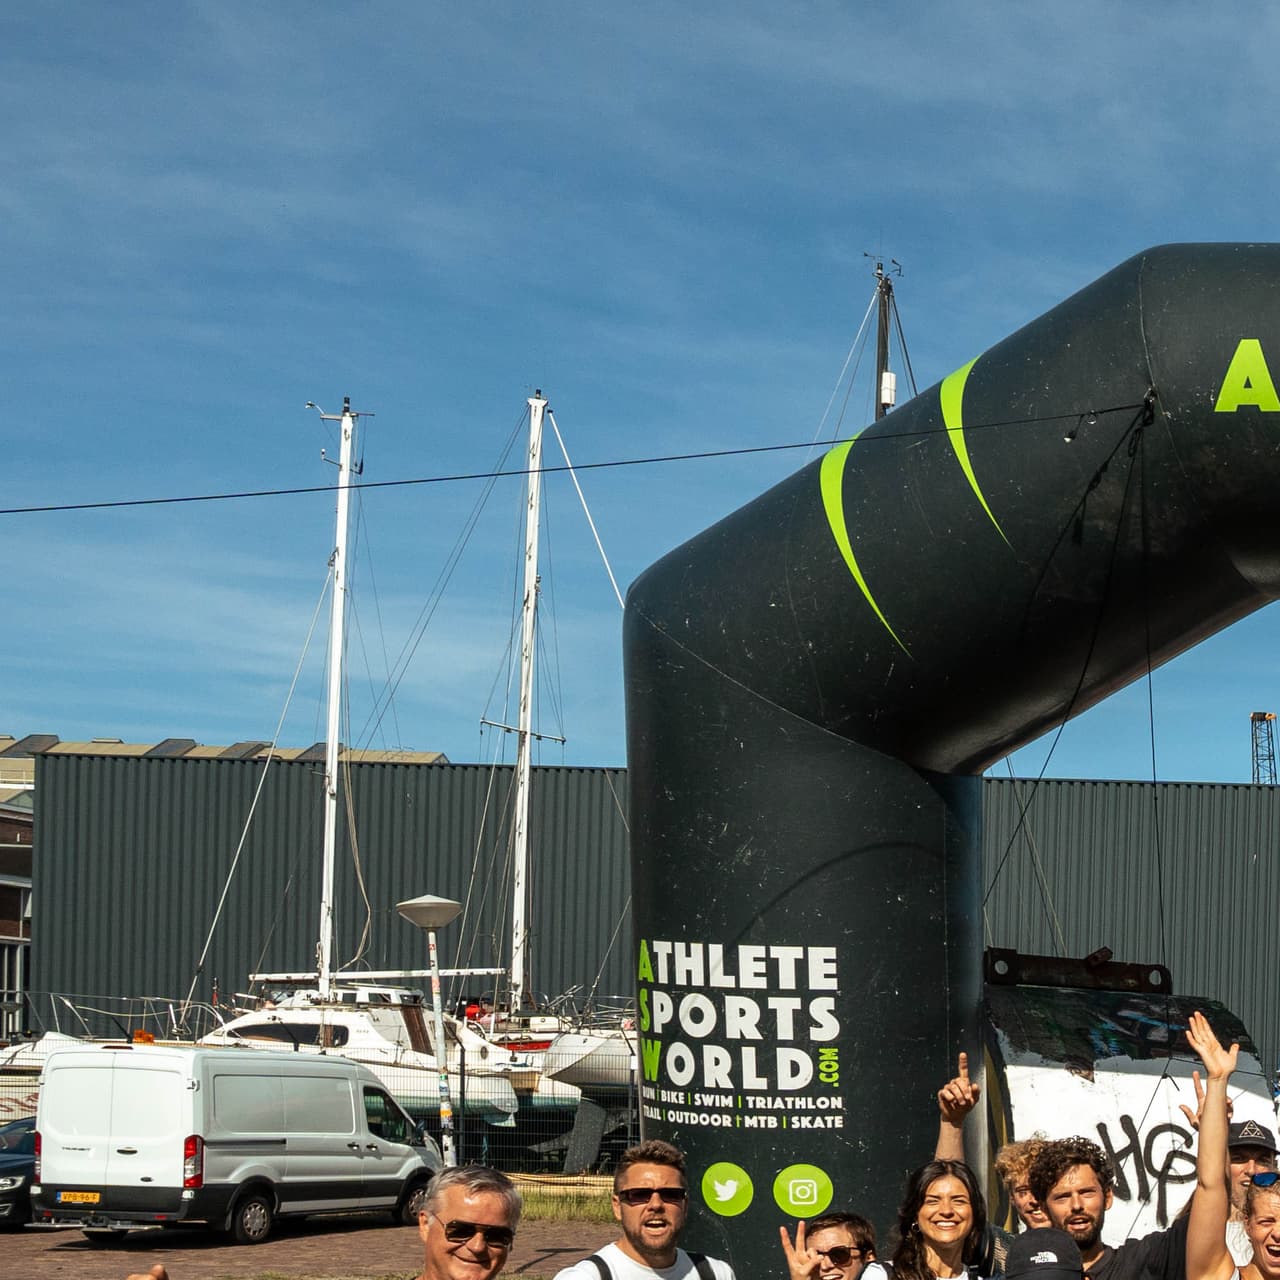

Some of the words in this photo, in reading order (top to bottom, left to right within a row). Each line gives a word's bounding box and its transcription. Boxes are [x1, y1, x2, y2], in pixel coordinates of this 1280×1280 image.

[638, 938, 839, 991] ATHLETE
[639, 987, 841, 1042] SPORTS
[641, 1039, 814, 1091] WORLD
[819, 1047, 839, 1088] .COM
[661, 1088, 685, 1105] BIKE
[694, 1092, 734, 1109] SWIM
[745, 1095, 843, 1111] TRIATHLON
[667, 1109, 733, 1127] OUTDOOR
[744, 1115, 778, 1129] MTB
[791, 1115, 844, 1130] SKATE
